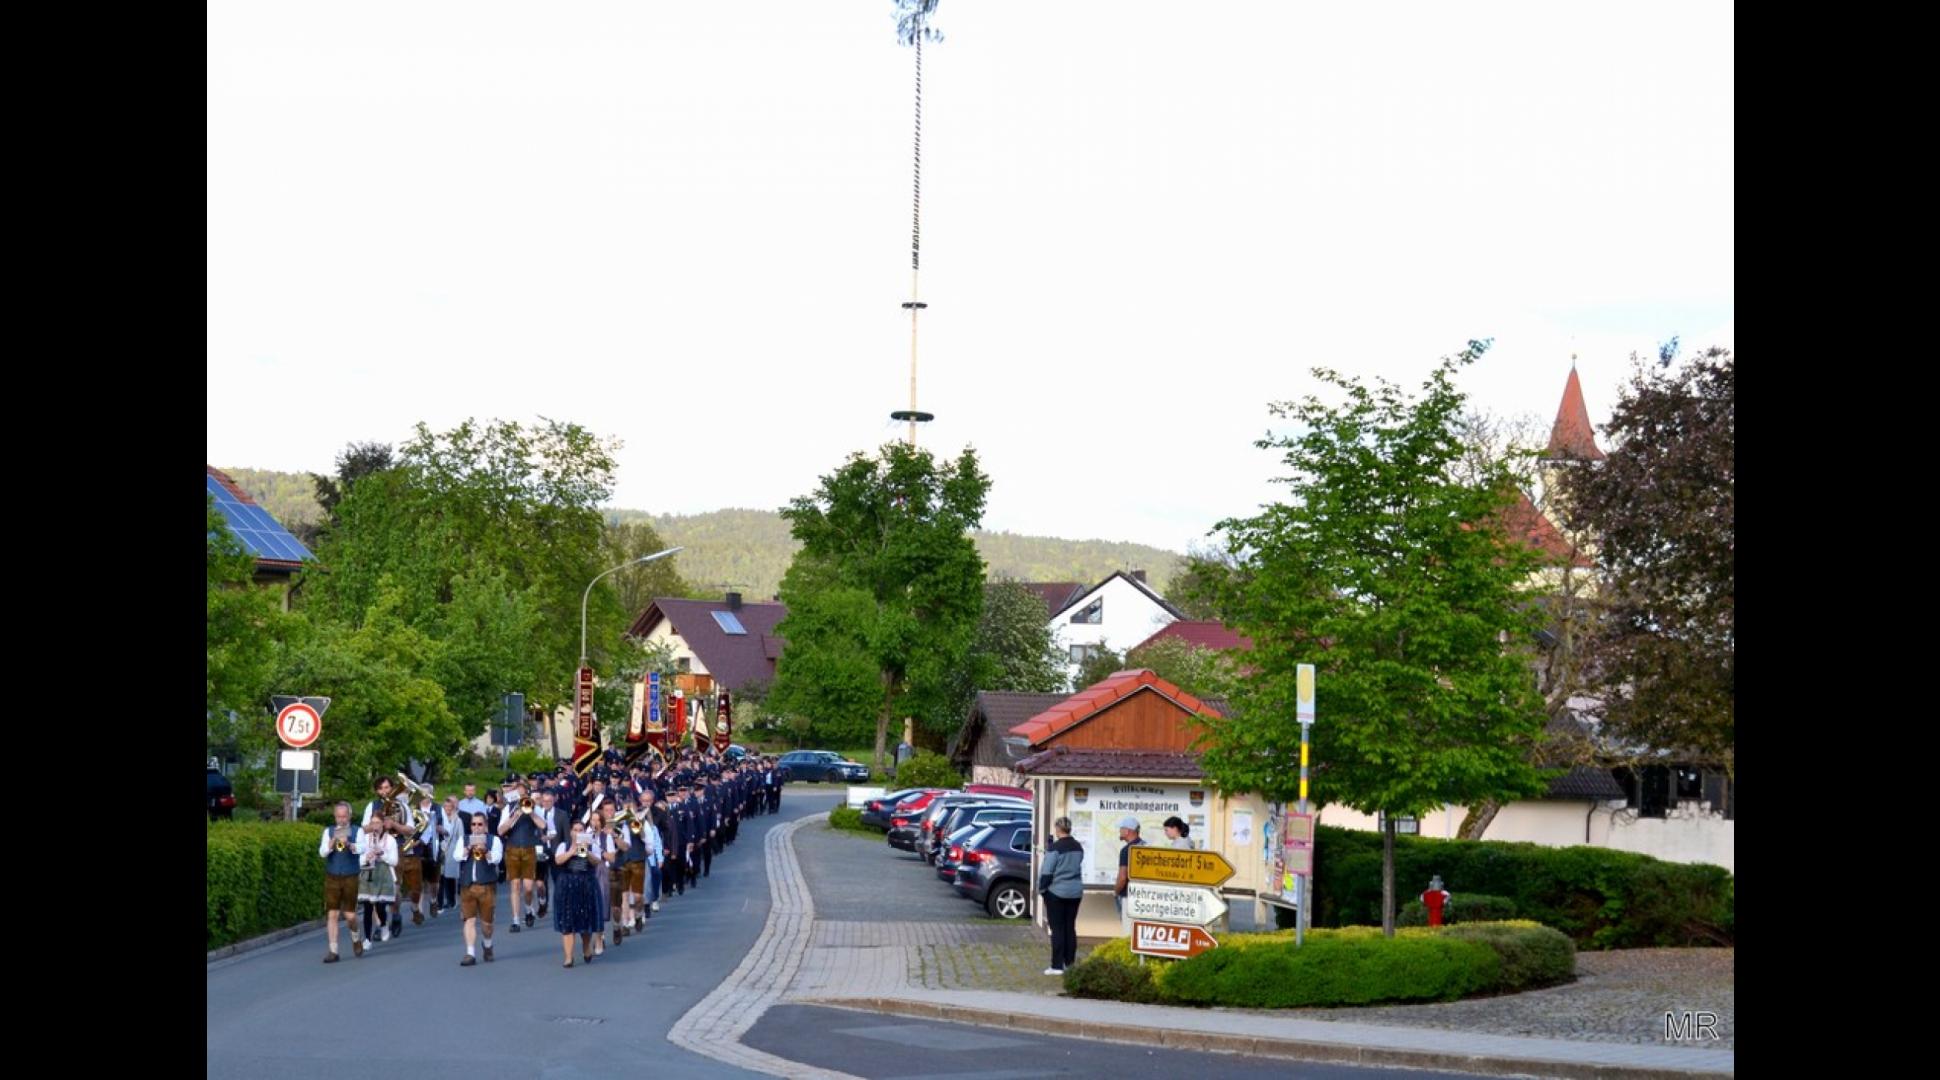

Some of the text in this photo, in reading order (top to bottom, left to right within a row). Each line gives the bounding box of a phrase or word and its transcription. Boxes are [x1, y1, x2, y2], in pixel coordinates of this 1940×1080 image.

[1112, 784, 1165, 796] Willkommen
[1099, 800, 1179, 812] Kirchenpingarten
[1136, 850, 1193, 870] Speichersdorf
[1128, 885, 1204, 904] Mehrzweckhalle
[1140, 925, 1190, 944] WOLF
